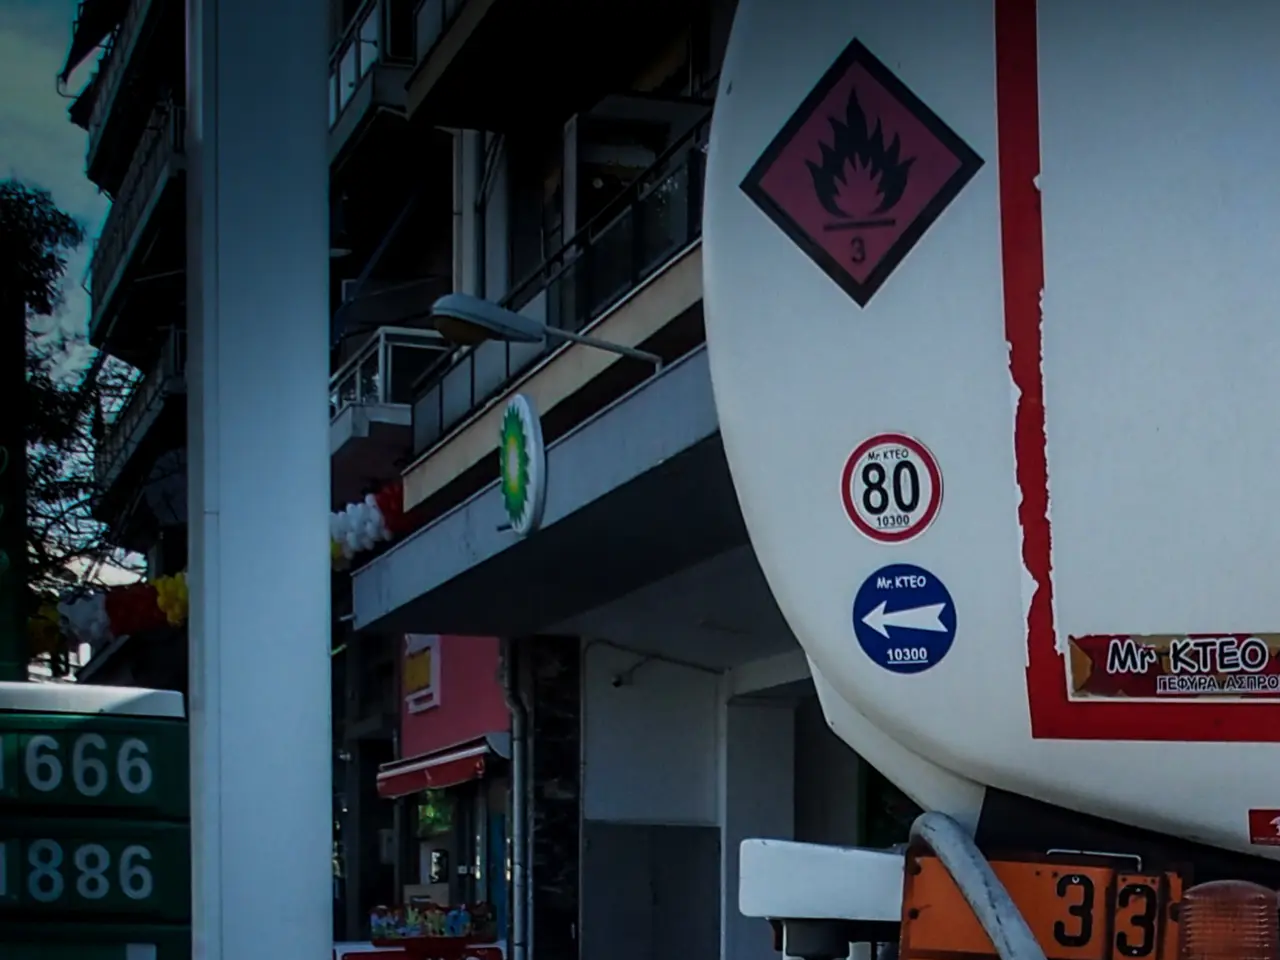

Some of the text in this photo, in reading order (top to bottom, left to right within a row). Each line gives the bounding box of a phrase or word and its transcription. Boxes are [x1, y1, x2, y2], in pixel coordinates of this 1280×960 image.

[850, 236, 866, 263] 3
[862, 460, 920, 514] 80
[876, 515, 910, 527] 10300
[886, 647, 928, 661] 10300
[1157, 675, 1216, 691] ΓΕΦΥΡΑ
